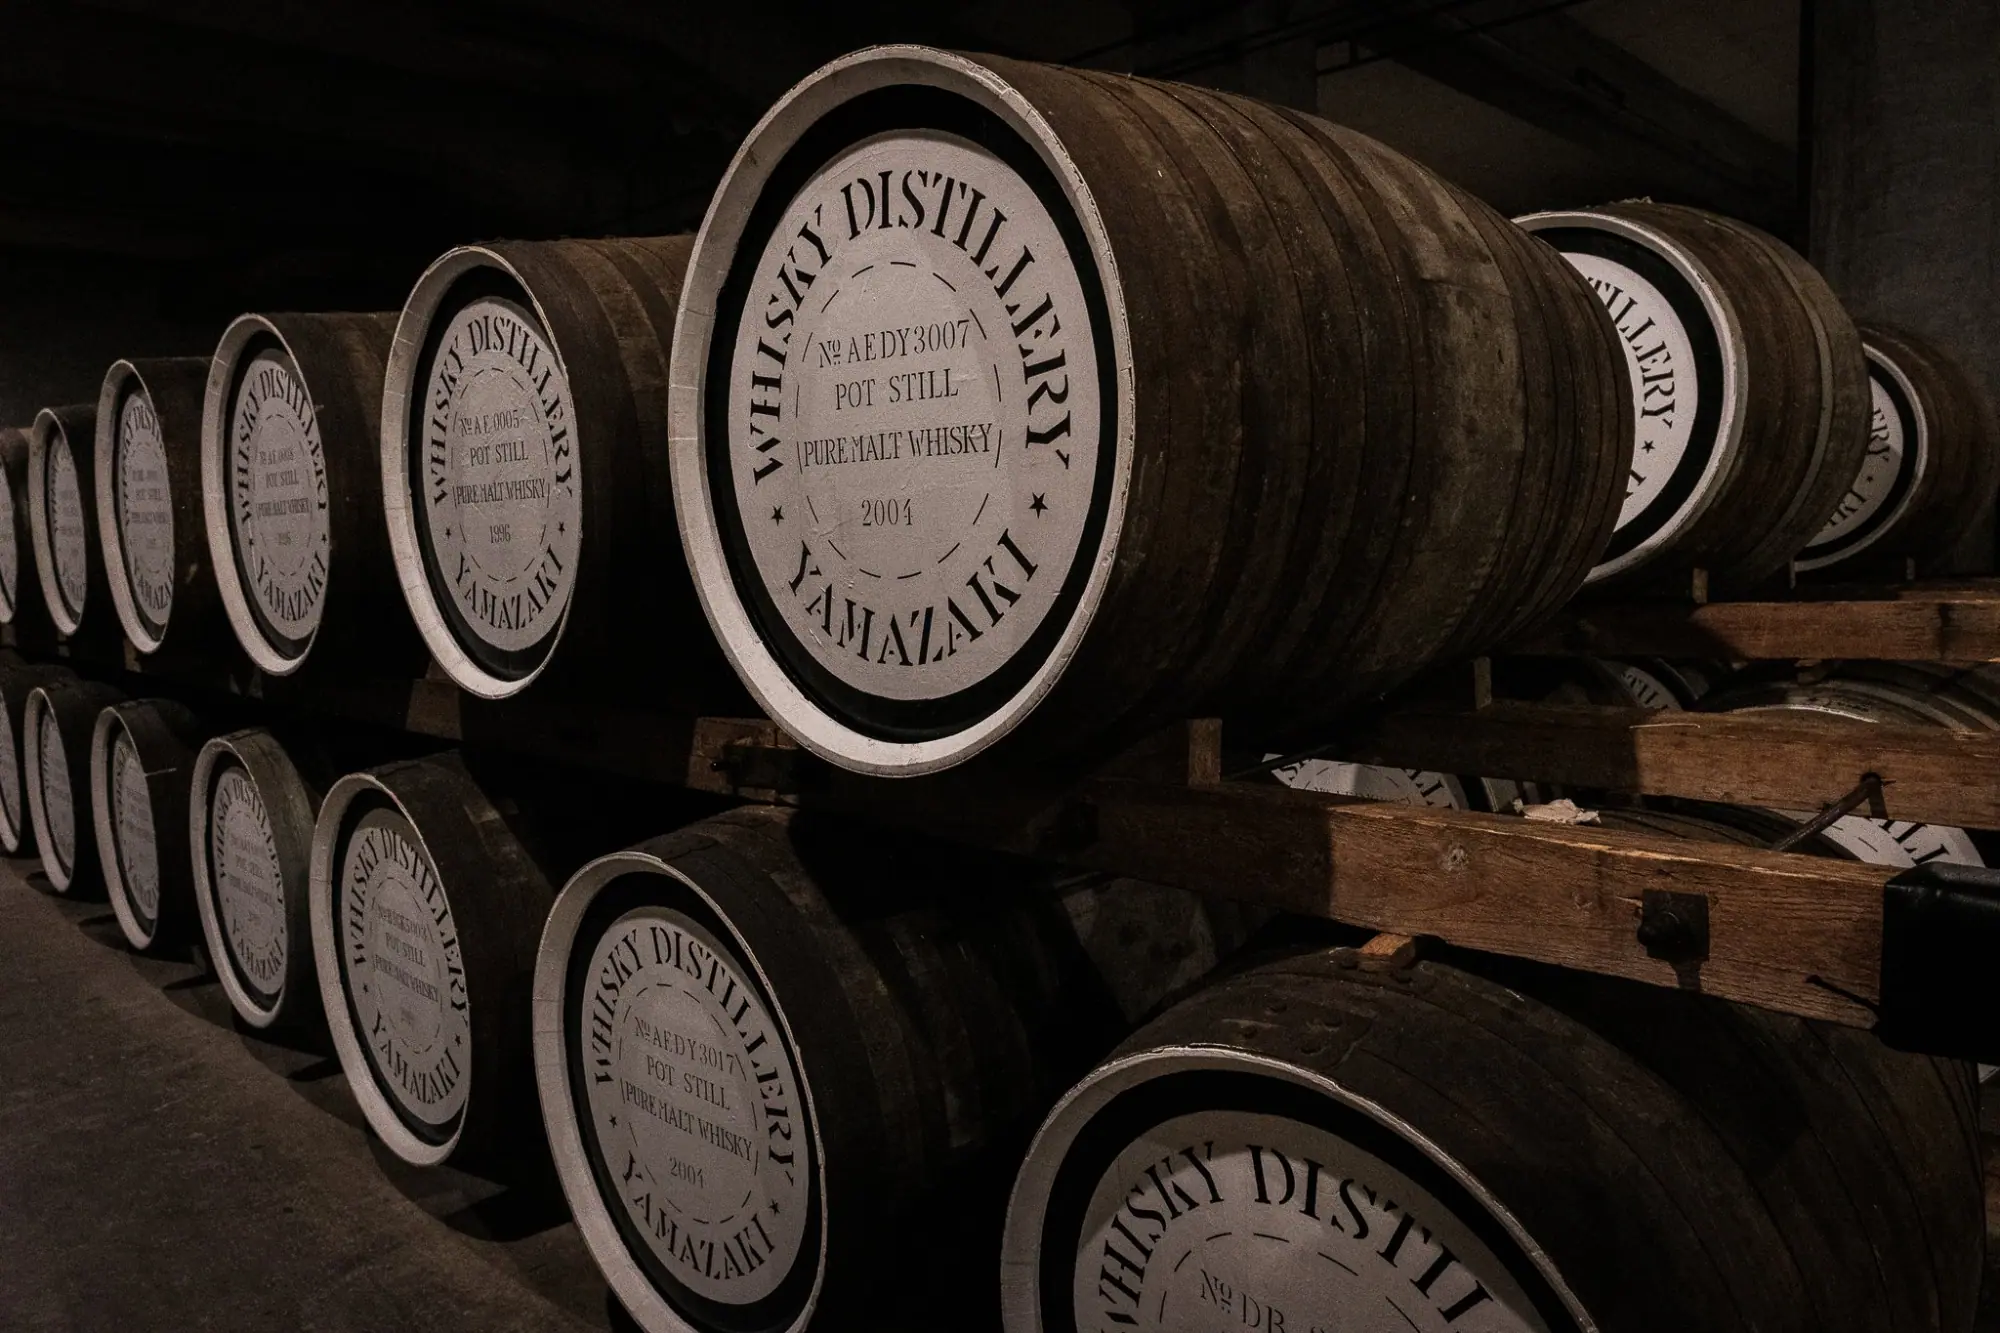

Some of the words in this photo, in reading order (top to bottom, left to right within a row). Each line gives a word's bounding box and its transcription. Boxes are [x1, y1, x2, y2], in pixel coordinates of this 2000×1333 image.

[749, 204, 832, 485] WHISKY
[841, 170, 1071, 469] DISTILLERY
[430, 335, 465, 505] WHISKY
[468, 316, 573, 497] DISTILLERY
[836, 379, 876, 410] POT
[889, 369, 959, 403] STILL
[470, 445, 490, 467] POT
[495, 441, 529, 463] STILL
[908, 423, 993, 457] WHISKY
[862, 499, 913, 526] 2004
[455, 543, 563, 631] YAMAZAKI
[788, 528, 1038, 666] YAMAZAKI
[592, 930, 645, 1085] WHISKY
[650, 926, 795, 1186] DISTILLERY
[646, 1054, 675, 1086] POT
[684, 1072, 730, 1110] STILL
[698, 1117, 752, 1161] WHISKY
[622, 1150, 775, 1281] YAMAZAKI
[1245, 1144, 1494, 1333] DISTIL
